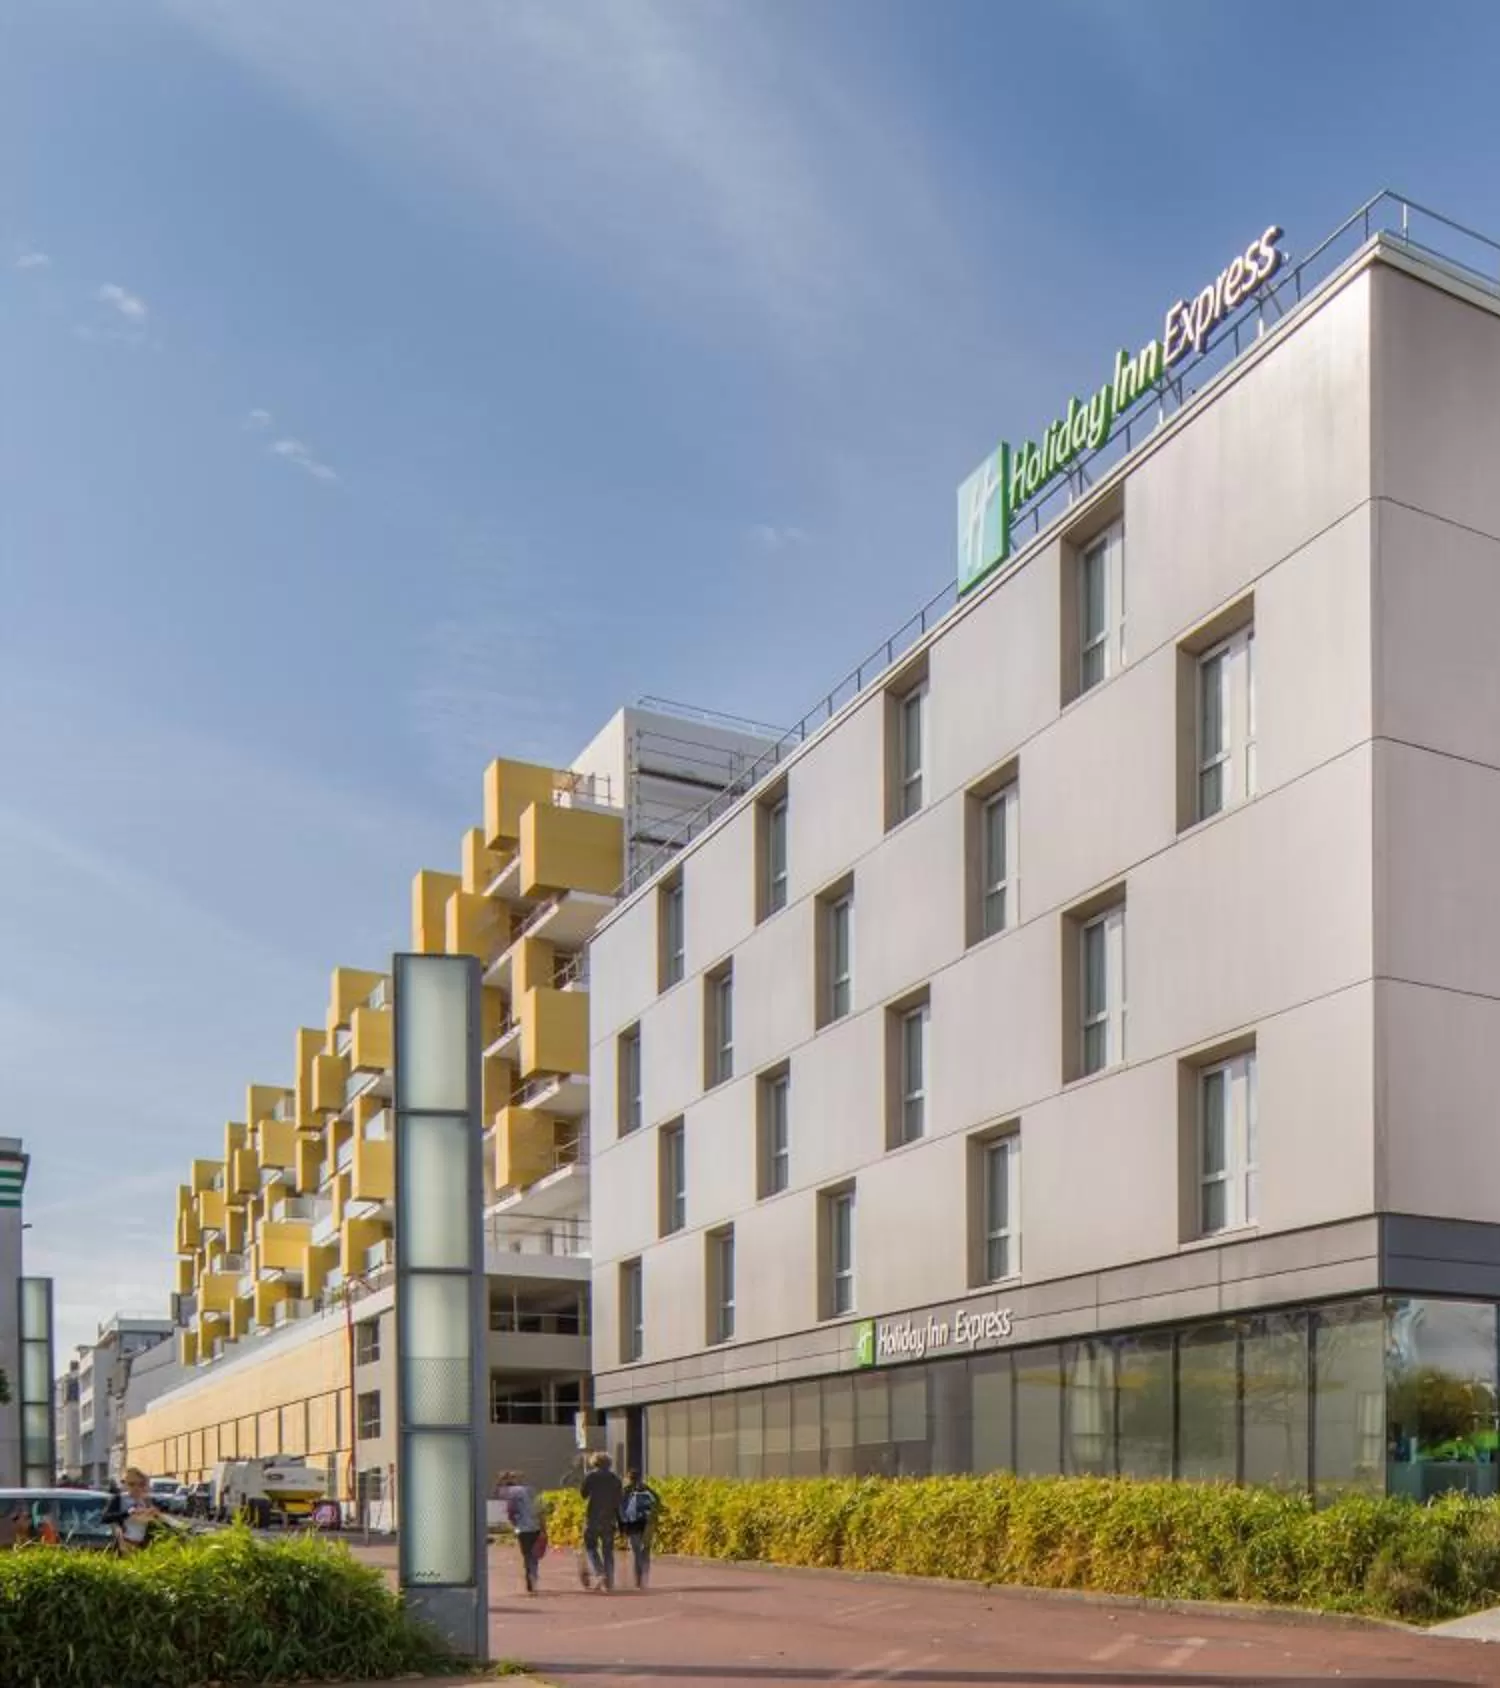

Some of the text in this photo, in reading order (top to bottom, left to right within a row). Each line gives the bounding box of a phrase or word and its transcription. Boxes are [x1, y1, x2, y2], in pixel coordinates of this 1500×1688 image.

[1006, 225, 1284, 508] Holiday Inn Express
[879, 1319, 927, 1358] Holiday
[927, 1315, 950, 1347] Inn
[954, 1308, 1013, 1350] Express
